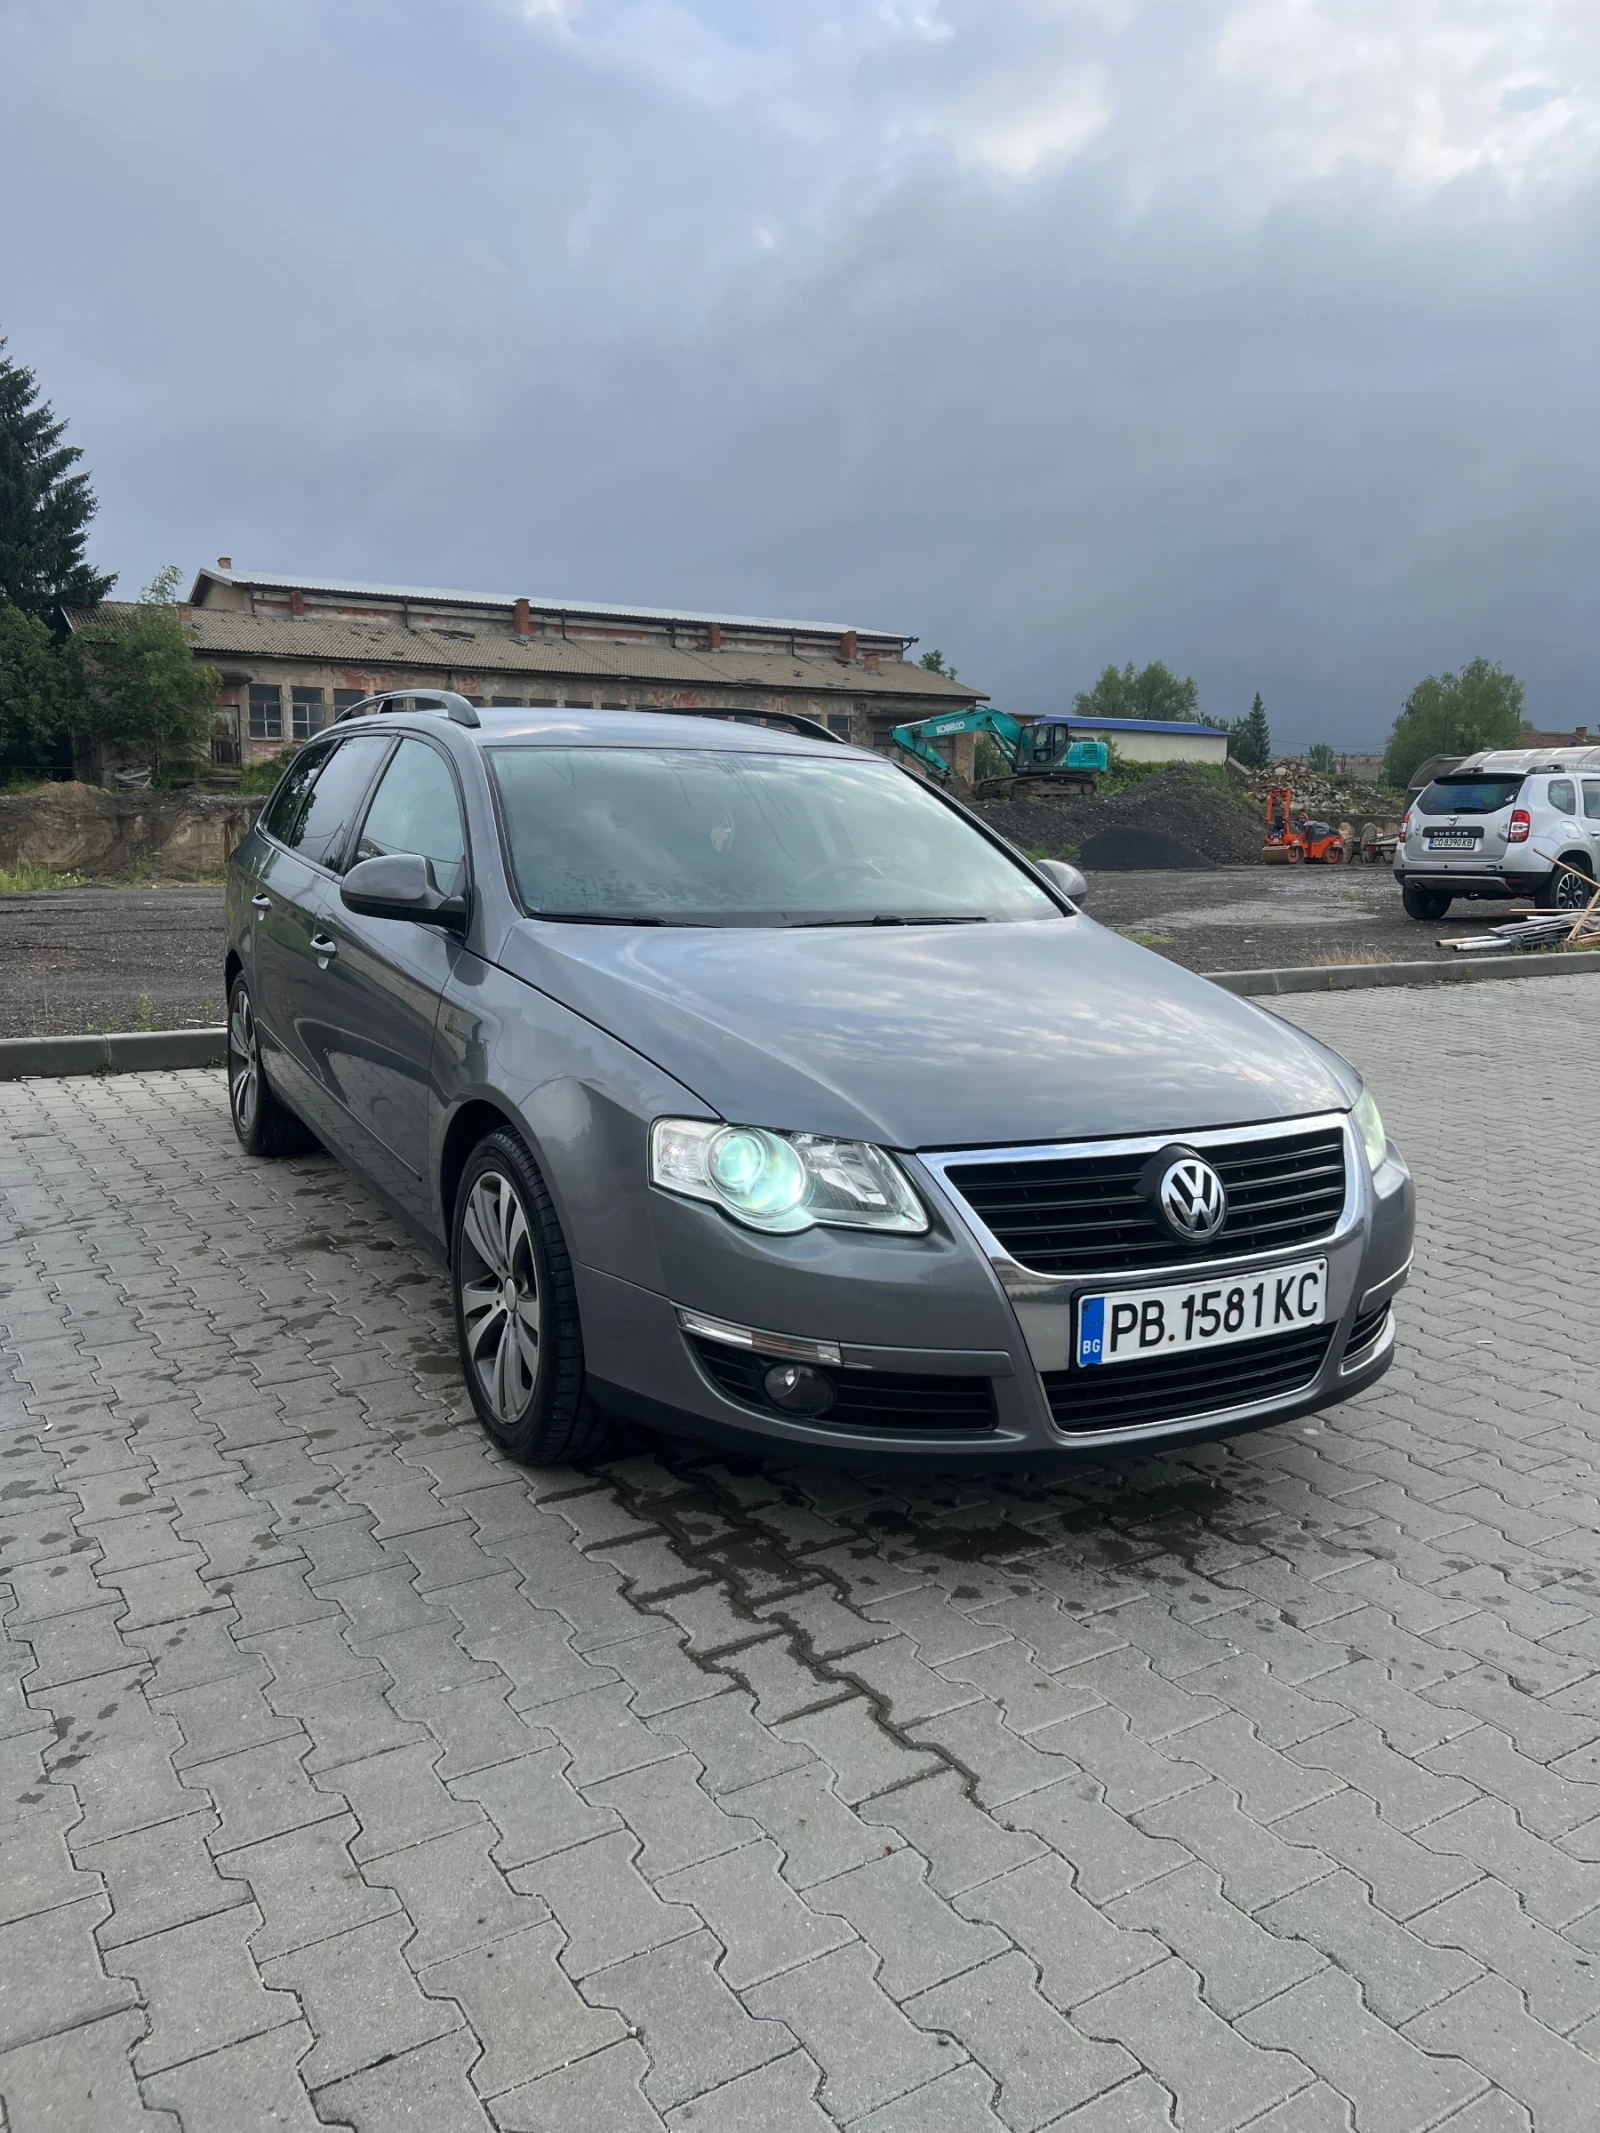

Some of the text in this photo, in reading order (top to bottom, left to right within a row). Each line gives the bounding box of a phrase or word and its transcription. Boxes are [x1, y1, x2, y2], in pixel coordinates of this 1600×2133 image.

[936, 721, 965, 735] KOBELCO
[1273, 1272, 1319, 1324] KC
[1082, 1338, 1101, 1355] BG
